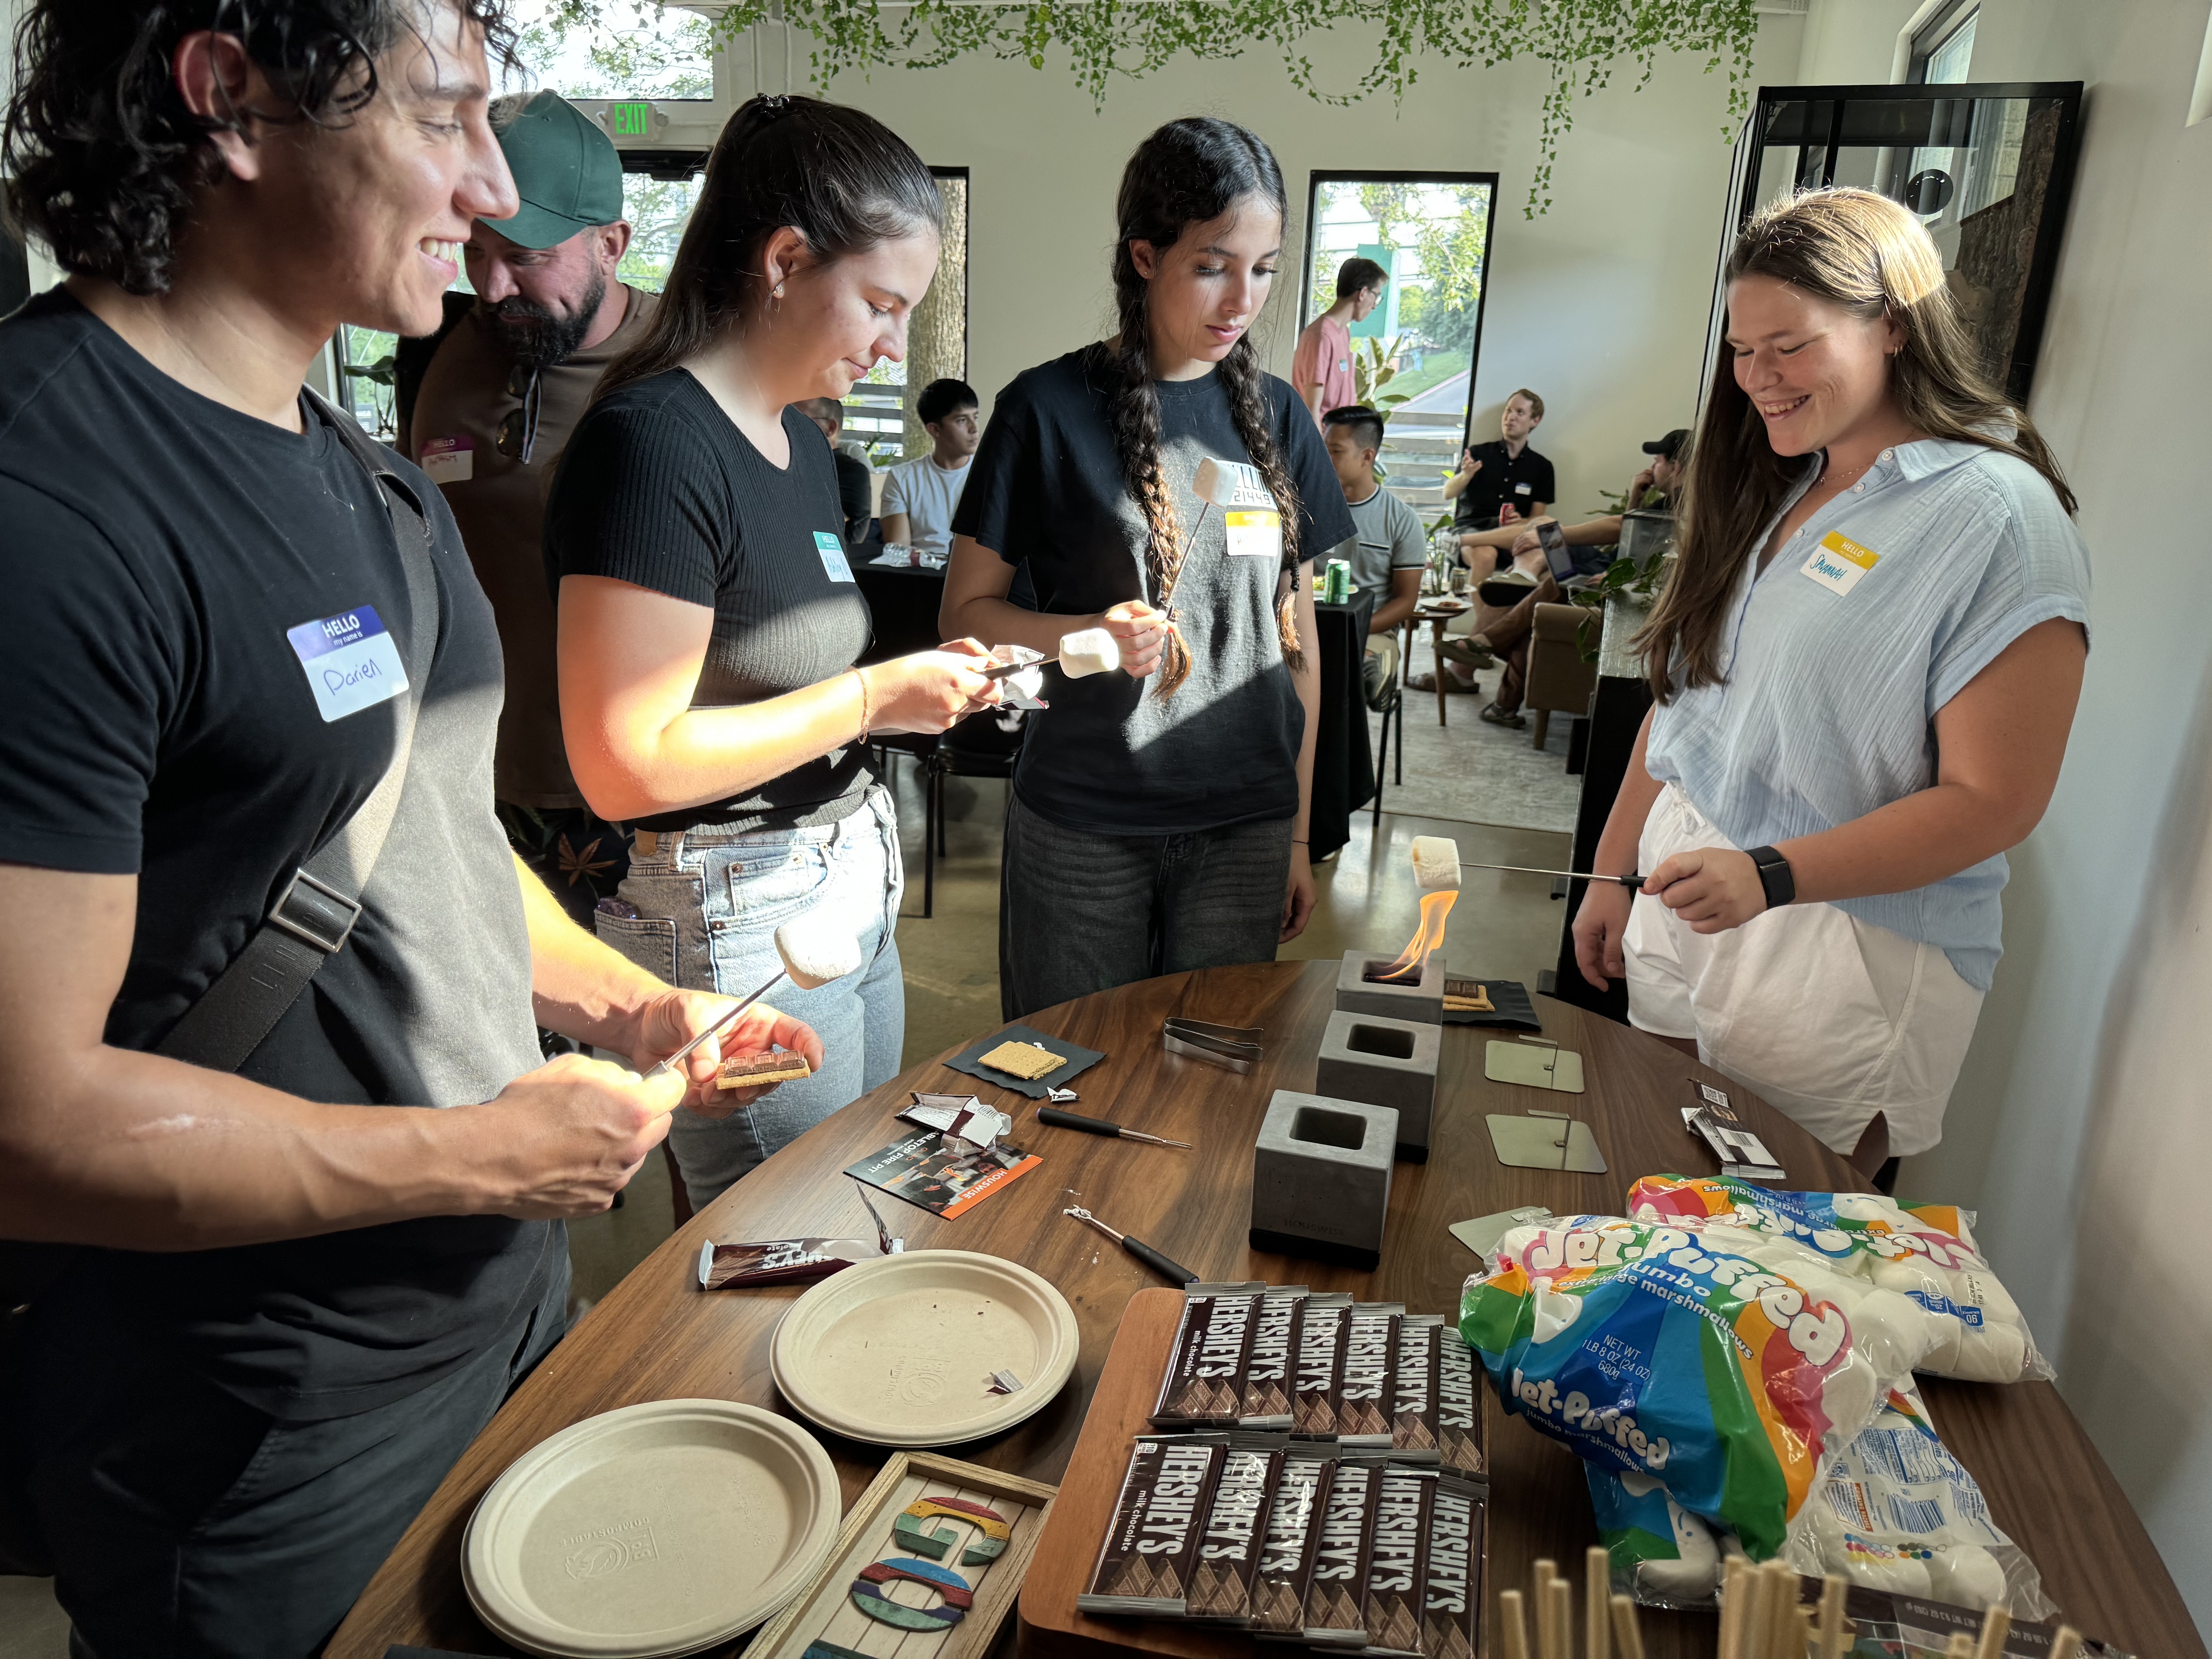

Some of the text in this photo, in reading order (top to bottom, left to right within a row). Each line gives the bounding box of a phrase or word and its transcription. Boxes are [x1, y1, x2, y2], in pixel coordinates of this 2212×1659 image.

[615, 104, 647, 134] EXIT
[822, 535, 835, 544] HELLO
[1841, 541, 1864, 558] HELLO
[321, 614, 360, 638] HELLO
[343, 632, 359, 643] name
[324, 658, 382, 696] Darien
[868, 1131, 939, 1173] ABLETOP FIRE PIT
[962, 1170, 1007, 1199] HOUSWISE
[1703, 1185, 1805, 1216] marshmallows
[1531, 1227, 1846, 1367] Jet-Puffed
[1558, 1276, 1599, 1287] extra
[1640, 1278, 1752, 1360] marshmallows
[1966, 1314, 1978, 1324] 90
[1183, 1331, 1201, 1376] milk chocolate
[1196, 1296, 1252, 1377] HERSHEY'S
[1247, 1298, 1293, 1381] HERSHEY'S
[1295, 1309, 1340, 1391] HERSHEY'S
[1341, 1315, 1389, 1400] HERSHEY'S
[1582, 1340, 1651, 1381] 1 LB 8 OZ (24 OZ)
[1604, 1334, 1641, 1360] NET WT
[1394, 1327, 1429, 1413] HERSHEY'S
[1439, 1339, 1473, 1429] HERSHEY'S
[1598, 1360, 1620, 1380] 680g
[1526, 1407, 1645, 1474] jumbo marshmallows
[1121, 1490, 1147, 1552] milk chocolate
[1136, 1446, 1211, 1554] HERSHEY'S
[1201, 1451, 1271, 1560] HERSHEY'S
[1259, 1461, 1322, 1571] HERSHEY'S
[1313, 1468, 1369, 1579] HERSHEY'S
[560, 1517, 649, 1547] COMPOSTABLE
[1369, 1477, 1422, 1591] HERSHEY'S
[1425, 1494, 1471, 1613] HERSHEY'S
